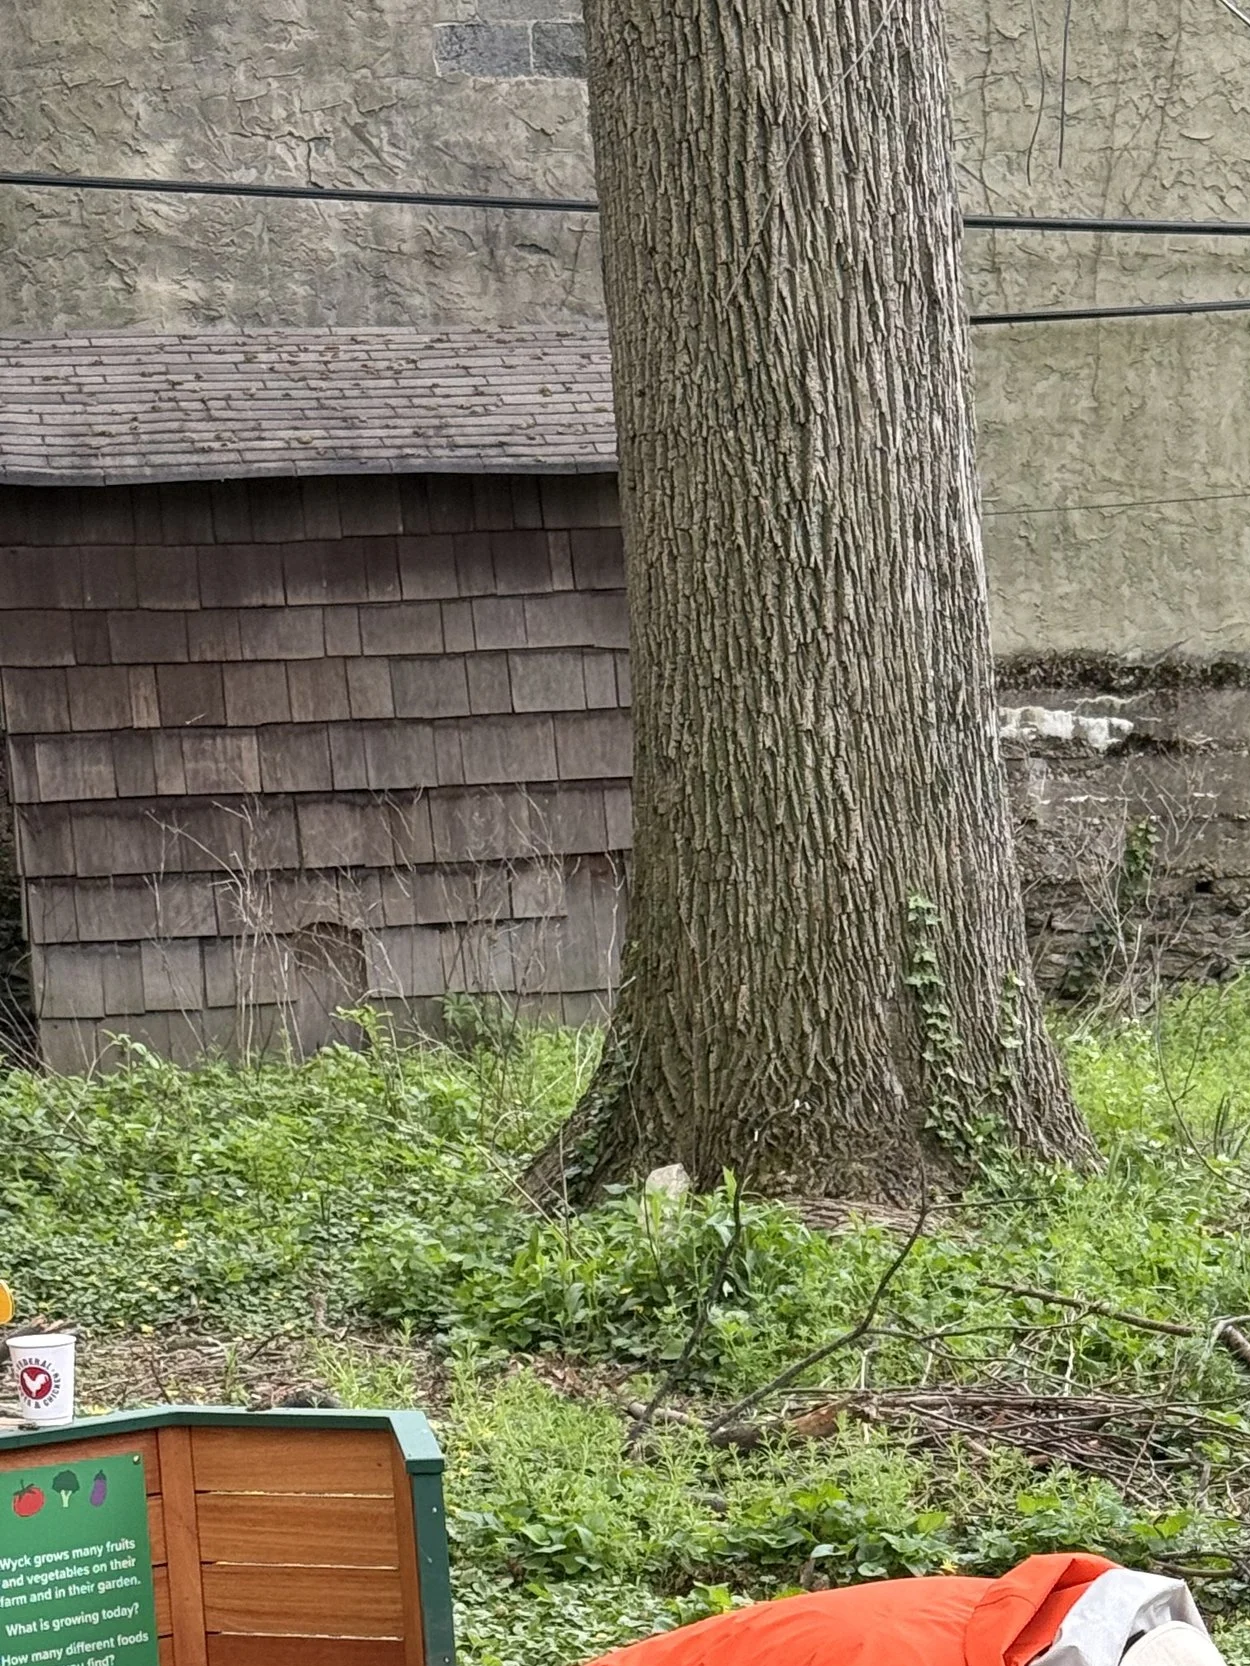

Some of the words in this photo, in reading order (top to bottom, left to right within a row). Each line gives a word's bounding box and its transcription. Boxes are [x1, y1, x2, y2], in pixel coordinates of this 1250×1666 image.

[0, 1554, 31, 1572] Wyck
[34, 1550, 70, 1568] grows
[72, 1545, 103, 1558] many
[105, 1538, 136, 1552] fruits
[1, 1574, 24, 1589] and
[26, 1565, 90, 1585] vegetables
[92, 1564, 107, 1574] on
[110, 1555, 136, 1570] their
[30, 1588, 52, 1603] and
[55, 1586, 66, 1599] in
[68, 1581, 95, 1597] their
[97, 1576, 141, 1594] garden.
[5, 1620, 38, 1637] What
[39, 1618, 50, 1631] is
[52, 1611, 99, 1631] growing
[101, 1602, 140, 1619] today?
[31, 1648, 63, 1662] many
[65, 1637, 115, 1656] different
[117, 1630, 149, 1646] foods
